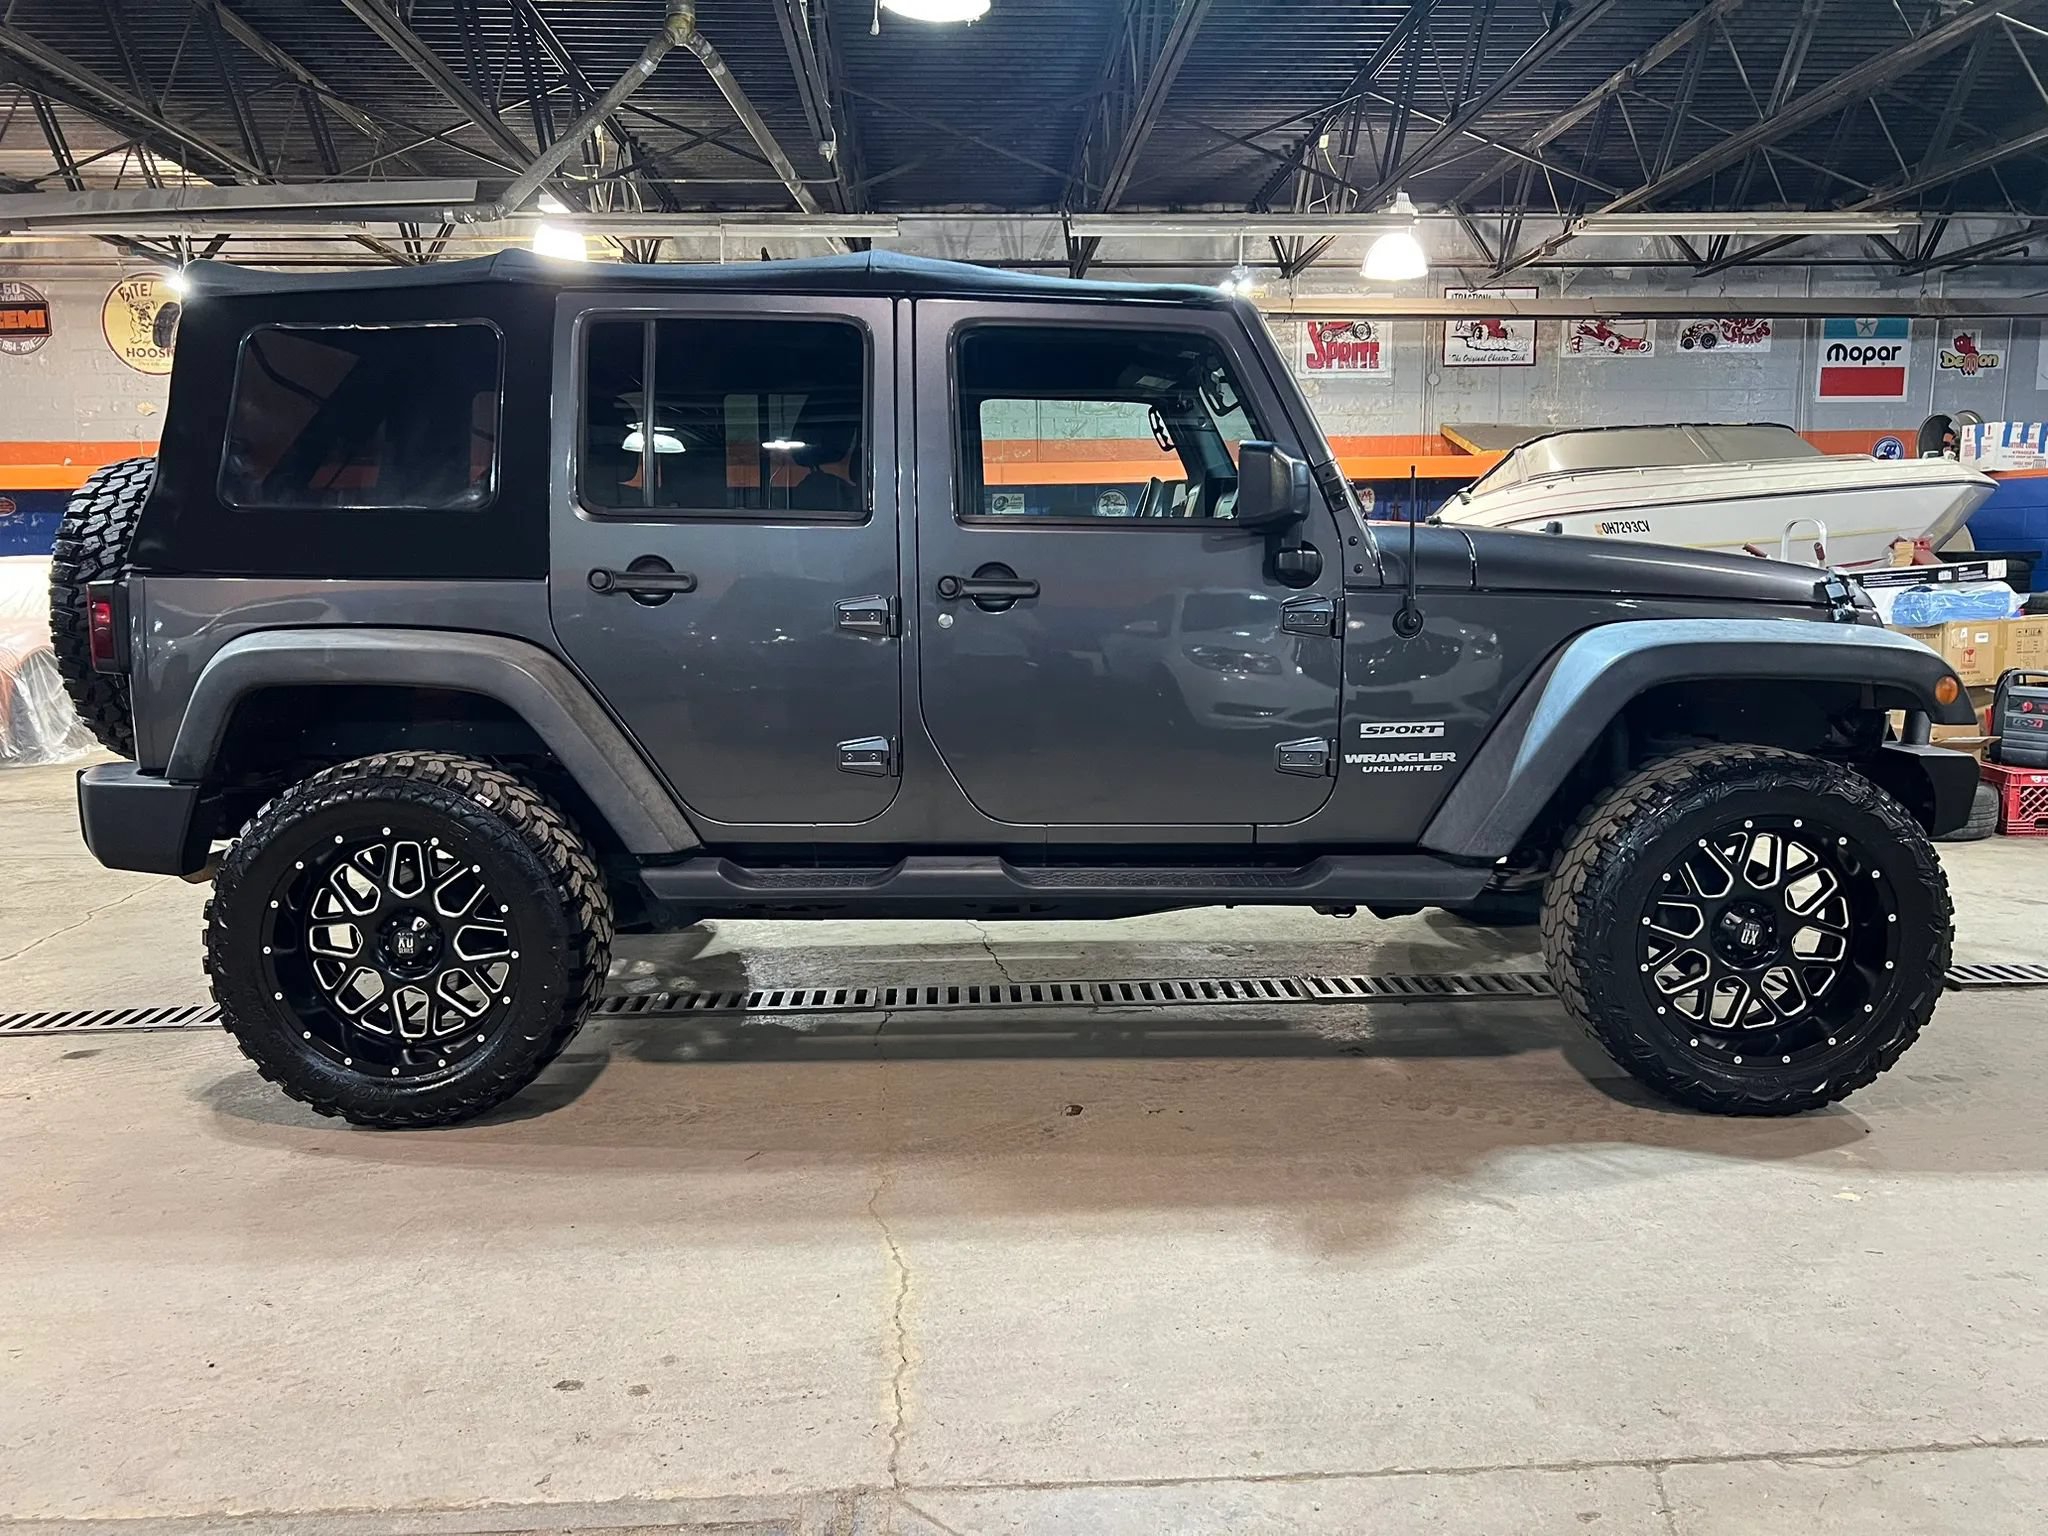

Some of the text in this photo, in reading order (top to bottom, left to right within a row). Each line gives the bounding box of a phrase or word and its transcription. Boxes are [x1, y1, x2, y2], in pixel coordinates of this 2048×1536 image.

[1306, 320, 1380, 369] SPRITE
[1362, 724, 1444, 736] SPORT
[1344, 751, 1457, 764] WRANGLER
[1362, 764, 1443, 773] UNLIMITED
